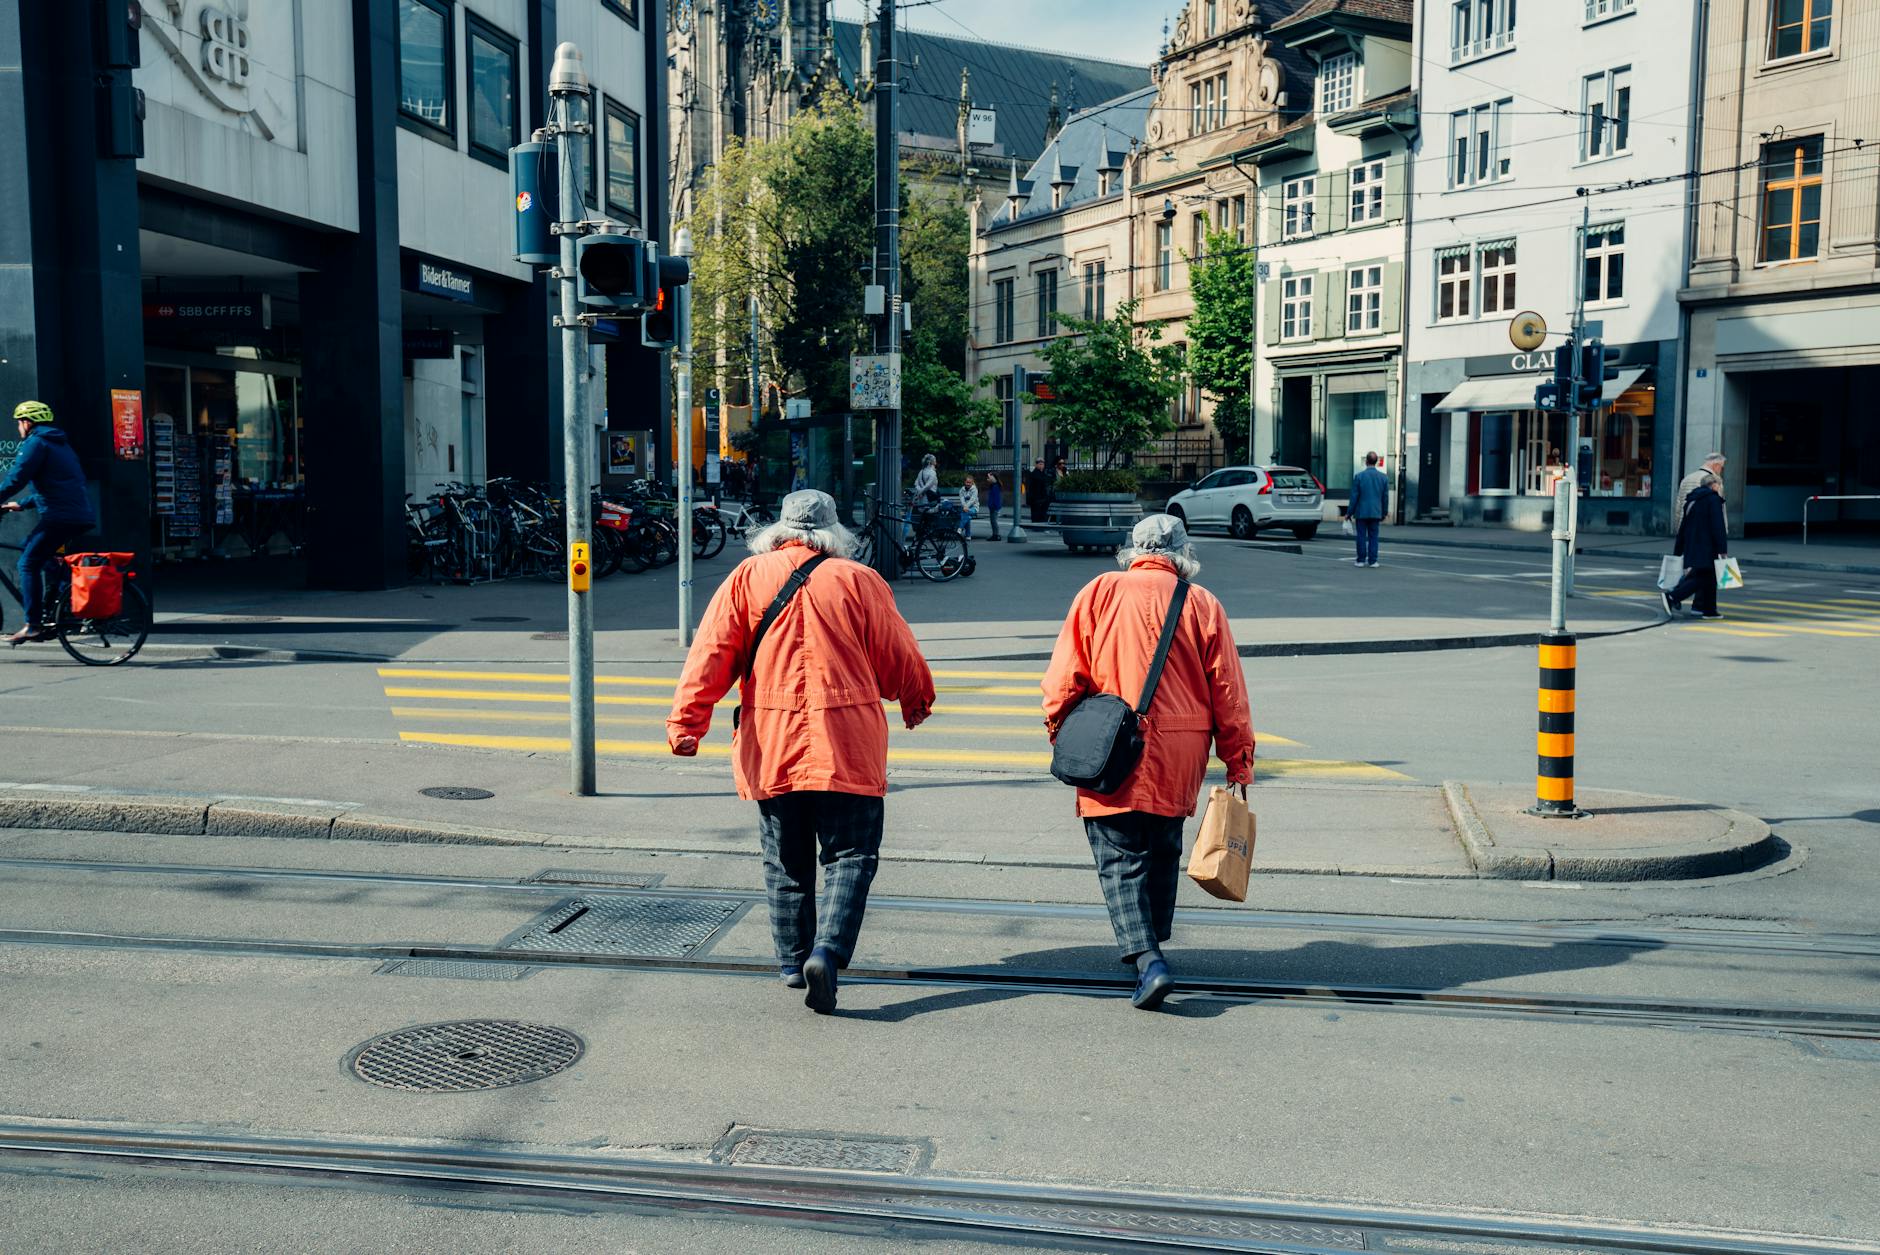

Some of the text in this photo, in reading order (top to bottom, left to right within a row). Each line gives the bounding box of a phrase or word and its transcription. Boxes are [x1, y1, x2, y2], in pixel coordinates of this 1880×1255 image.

[972, 113, 993, 122] W 96
[1258, 264, 1270, 275] 30
[422, 264, 470, 293] Bider&Tanner
[178, 305, 252, 317] SBB CFF FFS
[709, 389, 717, 399] C
